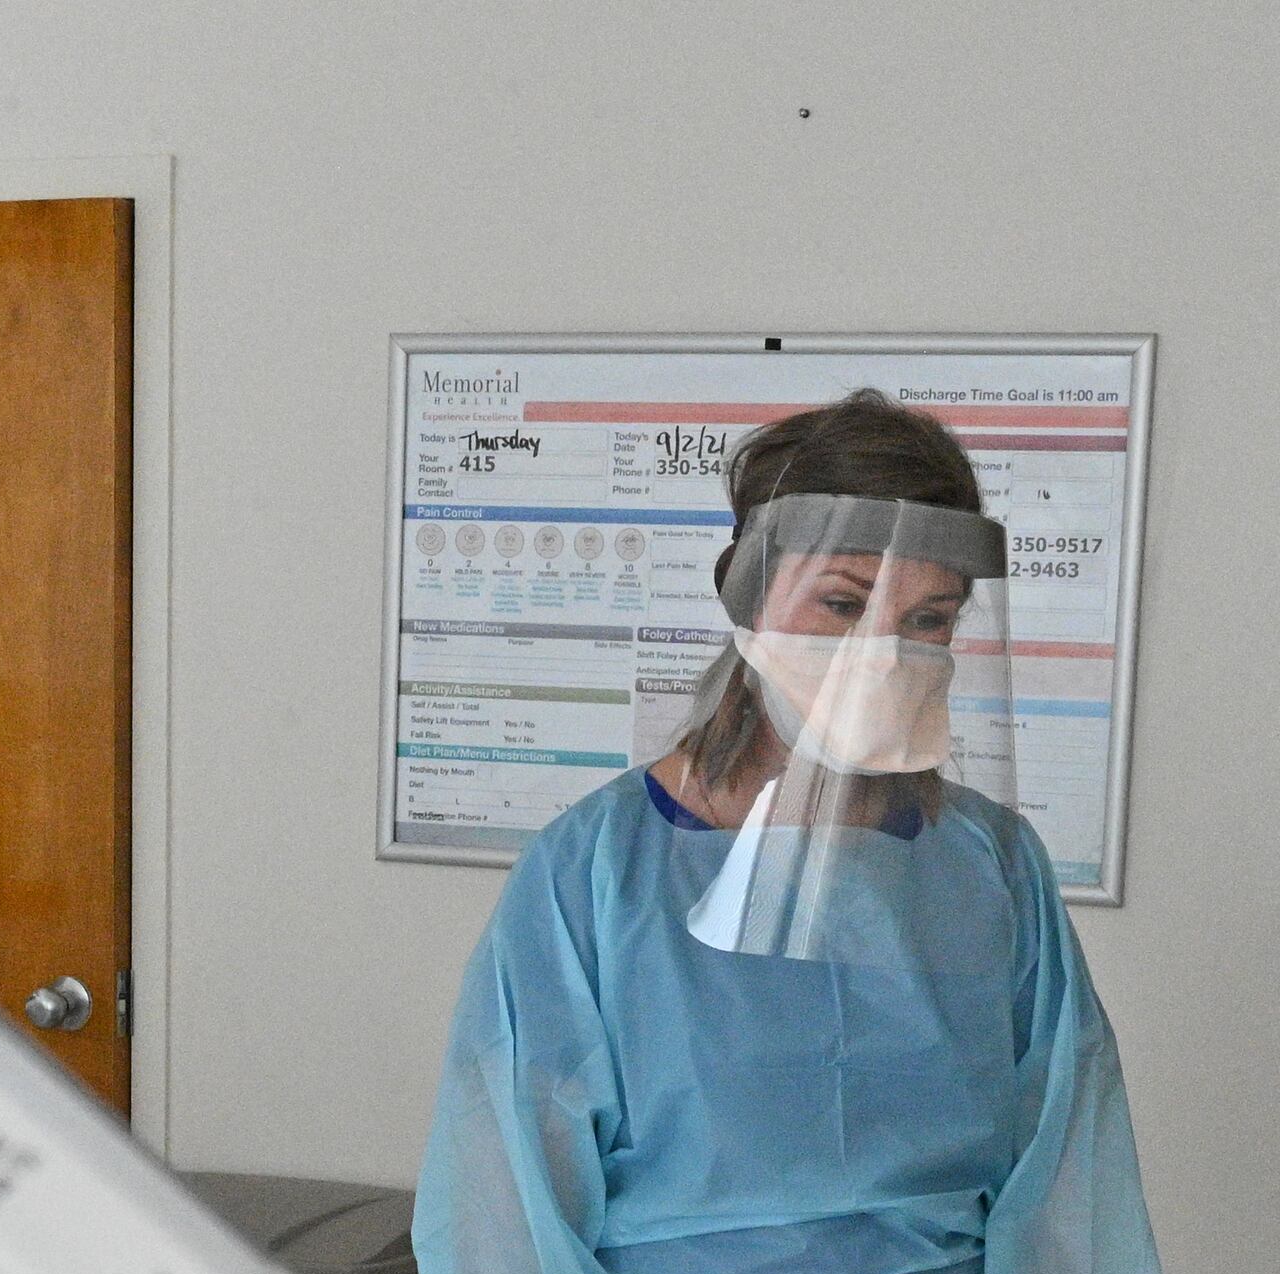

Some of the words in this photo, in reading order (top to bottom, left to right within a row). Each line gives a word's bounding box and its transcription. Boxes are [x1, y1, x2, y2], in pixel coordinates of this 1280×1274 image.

[422, 368, 519, 393] Memorial
[899, 388, 966, 402] Discharge
[971, 389, 1004, 401] Time
[1007, 389, 1039, 401] Goal
[1043, 389, 1054, 401] is
[1058, 390, 1094, 402] 11:00
[1097, 392, 1119, 402] am
[422, 412, 470, 423] Experience
[420, 434, 445, 444] Today
[449, 434, 456, 443] is
[459, 428, 541, 458] Thursday
[614, 432, 649, 443] Today's
[614, 443, 636, 453] Date
[656, 425, 727, 462] 9/2/21
[419, 454, 439, 463] Your
[459, 455, 496, 473] 415
[613, 456, 634, 466] Your
[418, 464, 446, 474] Room
[613, 467, 643, 477] Phone
[656, 459, 722, 476] 350-54
[418, 477, 448, 488] Family
[417, 488, 454, 498] Contact
[612, 485, 642, 495] Phone
[416, 506, 440, 517] Pain
[443, 507, 482, 519] Control
[1011, 536, 1103, 554] 350-9517
[624, 563, 634, 572] 10
[1010, 561, 1079, 578] 2-9463
[413, 621, 437, 633] New
[439, 622, 505, 635] Medications
[642, 628, 672, 641] Foley
[411, 683, 512, 698] Activity/Assistance
[409, 746, 431, 757] Diet
[433, 747, 489, 760] Plan/Menu
[492, 749, 556, 762] Restrictions
[409, 766, 438, 776] Nothing
[439, 767, 449, 776] by
[451, 767, 475, 777] Mouth
[457, 812, 483, 822] Phone
